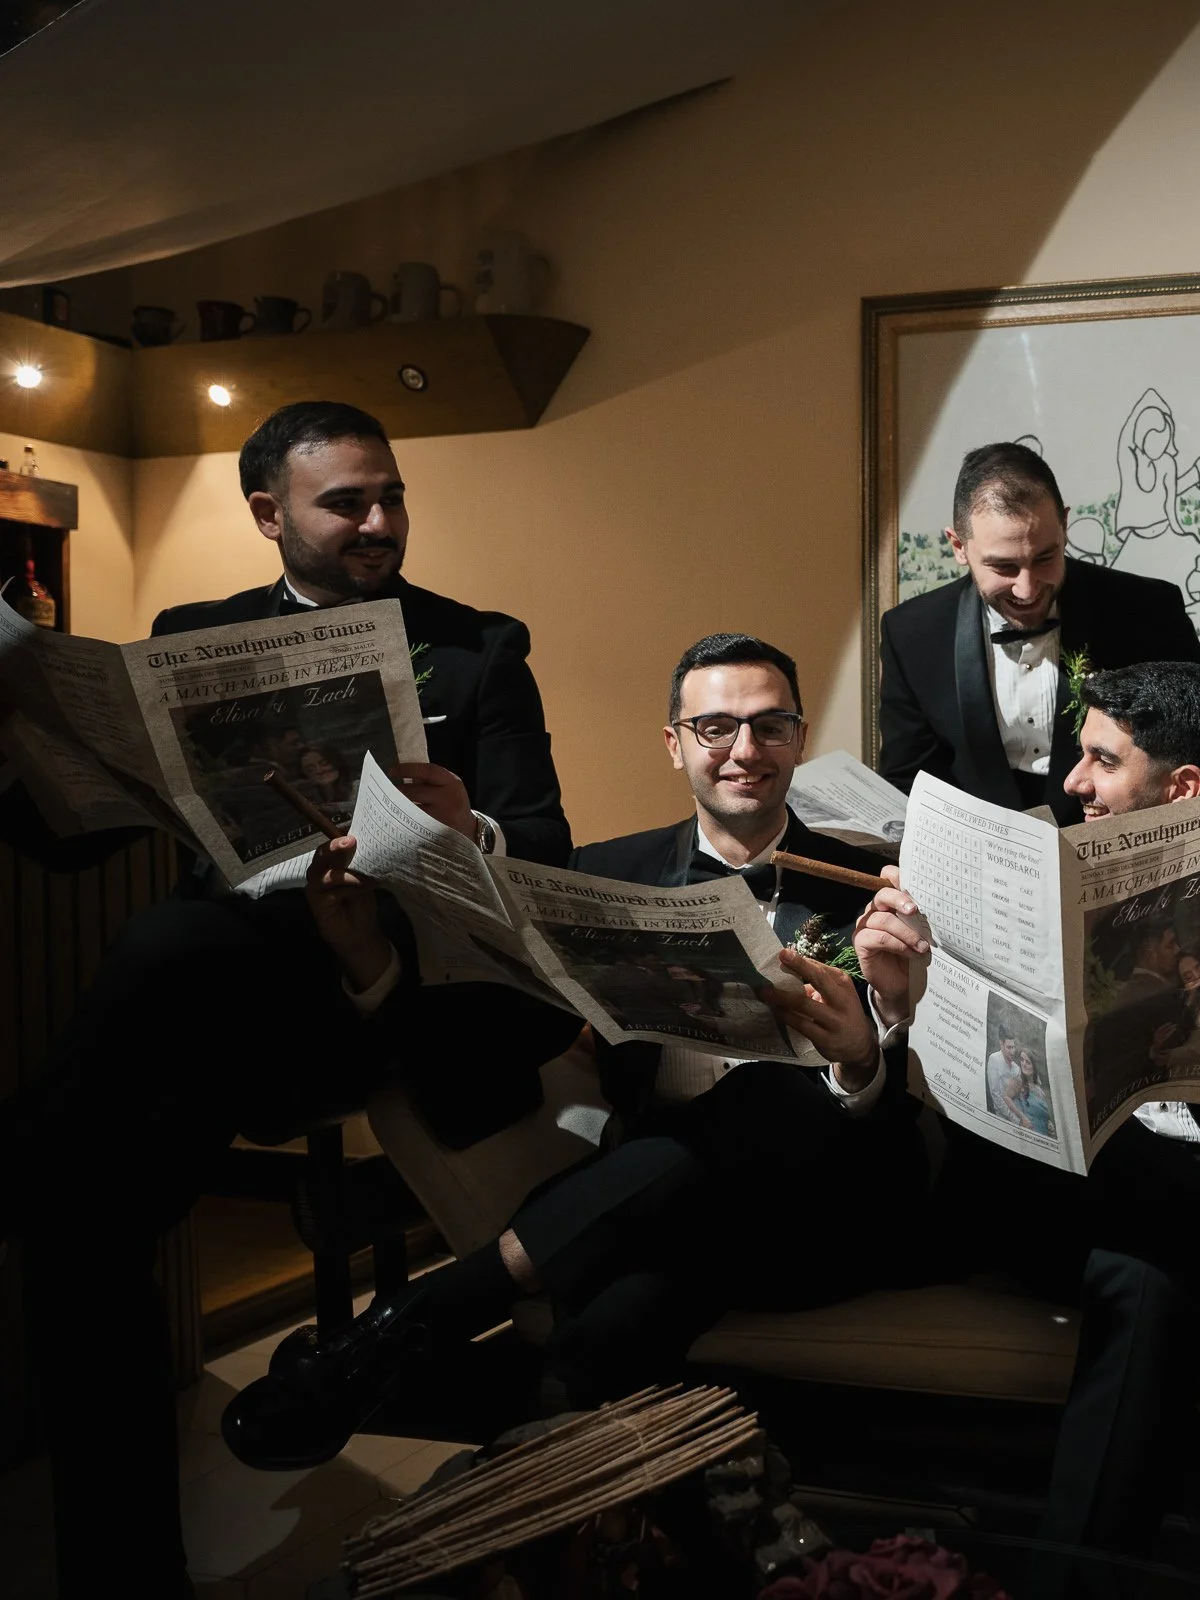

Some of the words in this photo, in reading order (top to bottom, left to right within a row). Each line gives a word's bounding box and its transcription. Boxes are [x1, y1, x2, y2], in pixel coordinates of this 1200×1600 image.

[148, 650, 191, 669] The
[194, 631, 306, 660] Newlywed
[314, 621, 378, 641] Times
[159, 692, 170, 703] A
[175, 681, 242, 700] MATCH
[243, 672, 290, 692] MADE
[295, 667, 311, 680] IN
[316, 652, 385, 675] HEAVEN!
[304, 677, 359, 708] Zach
[943, 803, 953, 814] THE
[952, 807, 986, 828] NEWLYWED
[986, 821, 1010, 836] TIMES
[244, 840, 274, 860] ARE
[986, 852, 1041, 880] WORDSEARCH
[1077, 840, 1113, 860] The
[507, 869, 546, 888] The
[547, 877, 648, 906] Newlywed
[654, 894, 721, 908] Times
[1078, 890, 1087, 904] A
[1092, 875, 1144, 900] MATCH
[1144, 860, 1183, 885] MADE
[1185, 854, 1200, 870] IN
[520, 904, 531, 913] A
[536, 904, 595, 922] MATCH
[595, 914, 640, 928] MADE
[643, 920, 660, 928] IN
